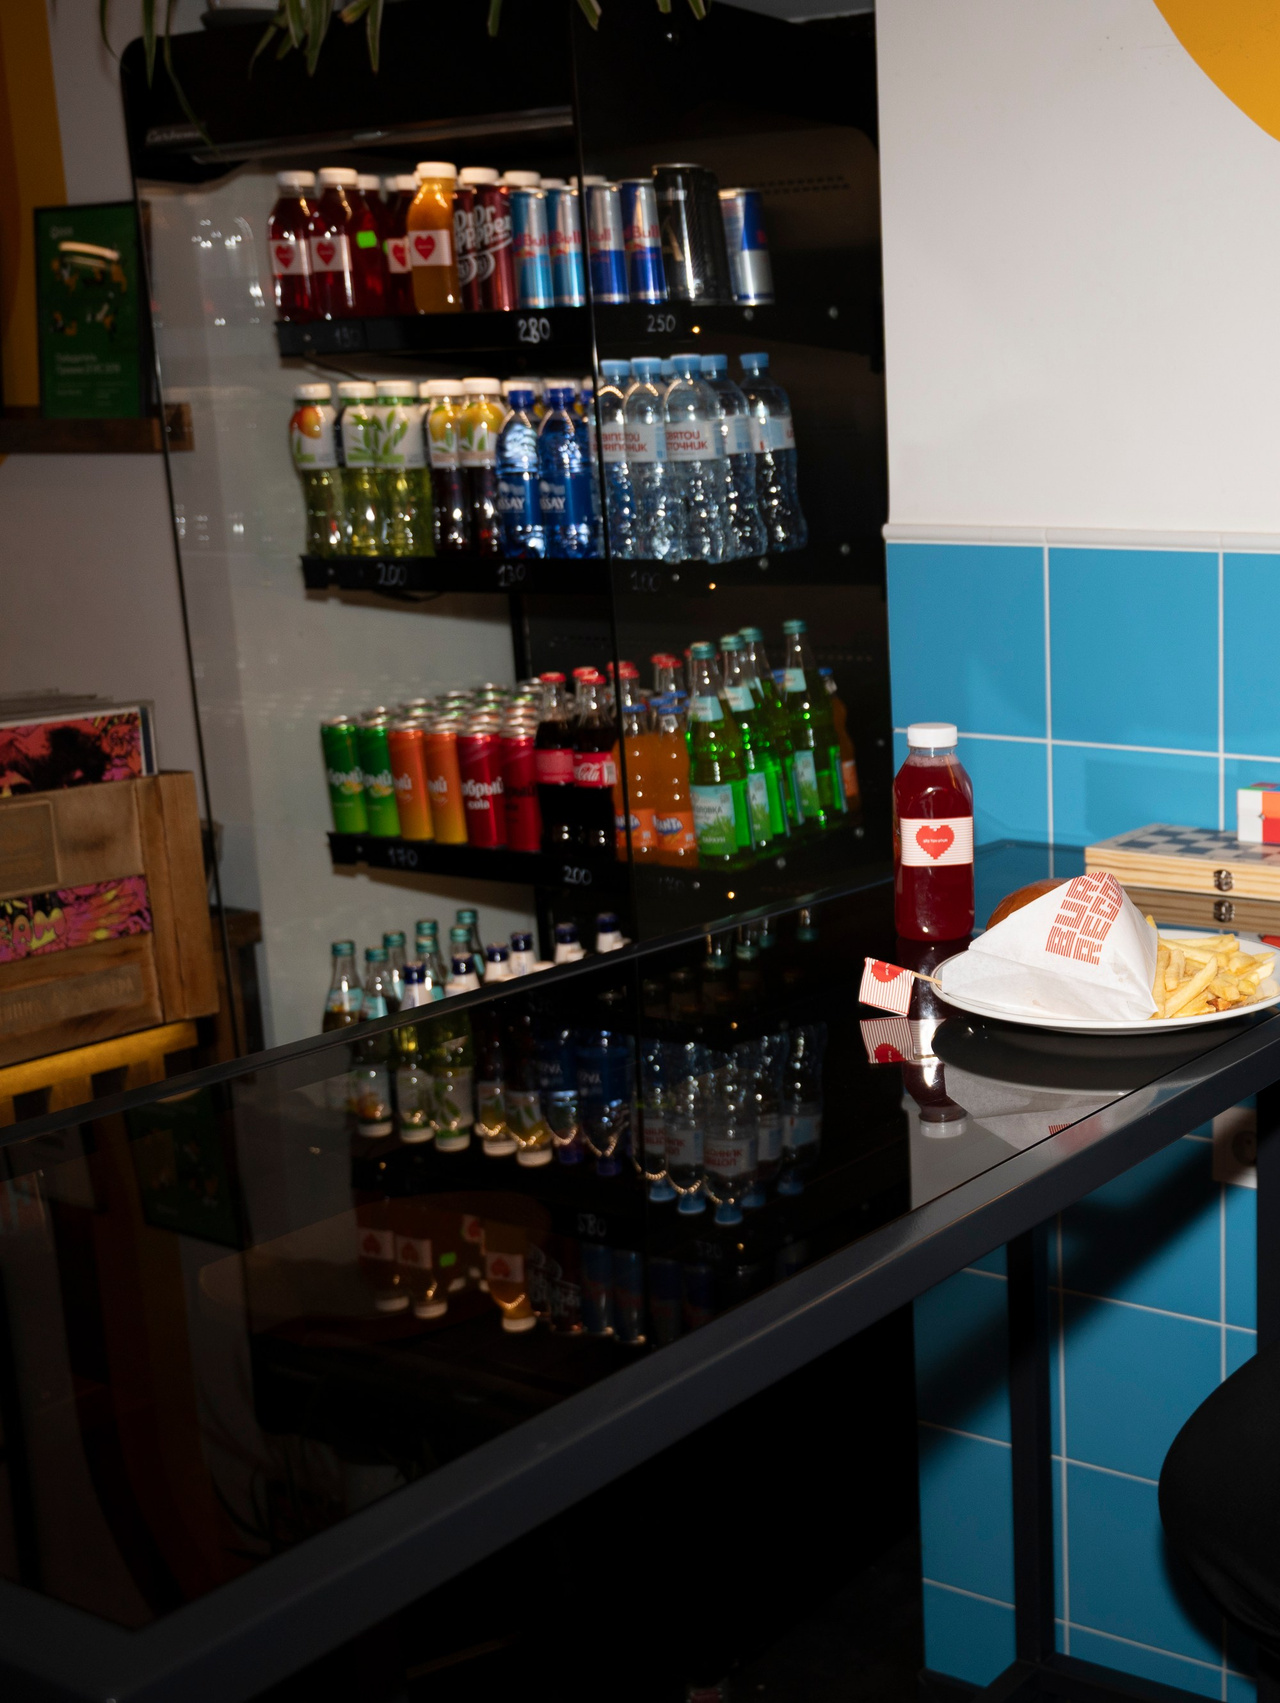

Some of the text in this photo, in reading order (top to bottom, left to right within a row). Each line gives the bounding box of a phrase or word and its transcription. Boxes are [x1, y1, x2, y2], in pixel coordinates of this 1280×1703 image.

[517, 317, 550, 344] 280
[647, 314, 676, 333] 250
[376, 562, 407, 587] 200
[563, 864, 593, 886] 200
